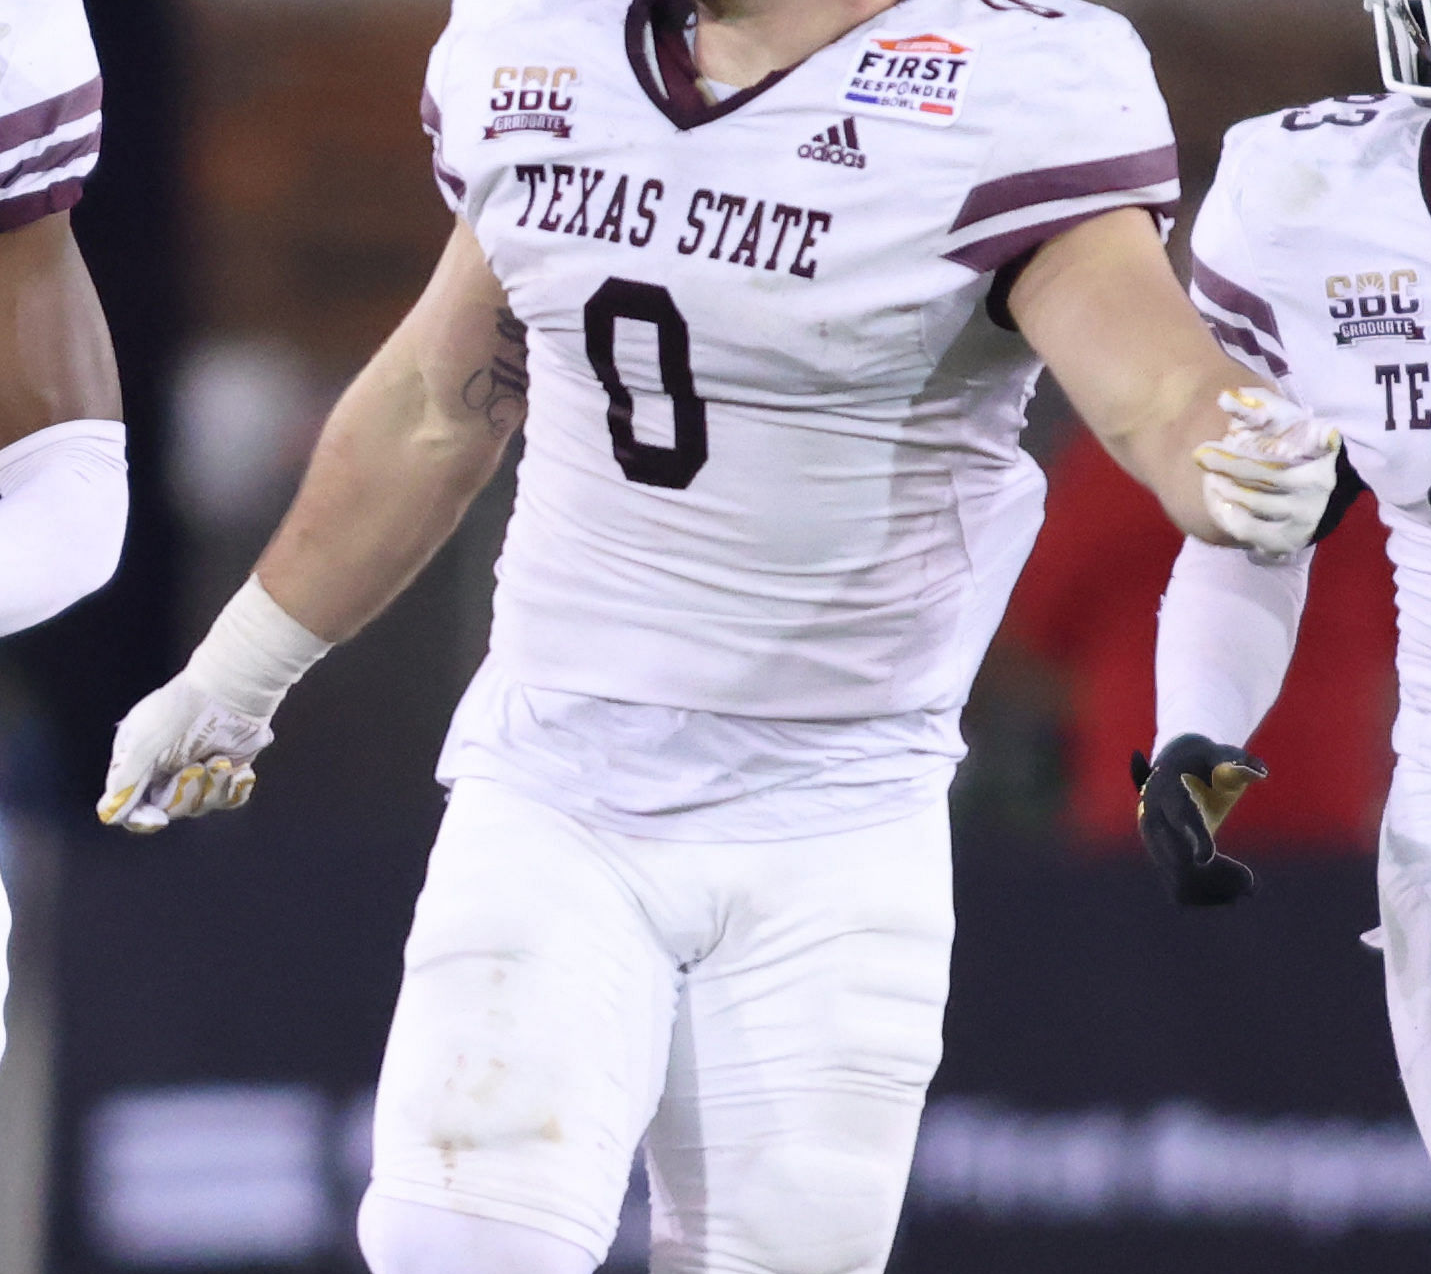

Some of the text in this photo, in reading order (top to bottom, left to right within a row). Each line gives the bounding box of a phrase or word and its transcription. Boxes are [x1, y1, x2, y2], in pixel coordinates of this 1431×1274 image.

[490, 67, 578, 112] SBC
[515, 163, 833, 280] TEXAS STATE
[1325, 270, 1420, 319] SBC
[1341, 320, 1414, 338] GRADUATE
[583, 275, 709, 490] 0
